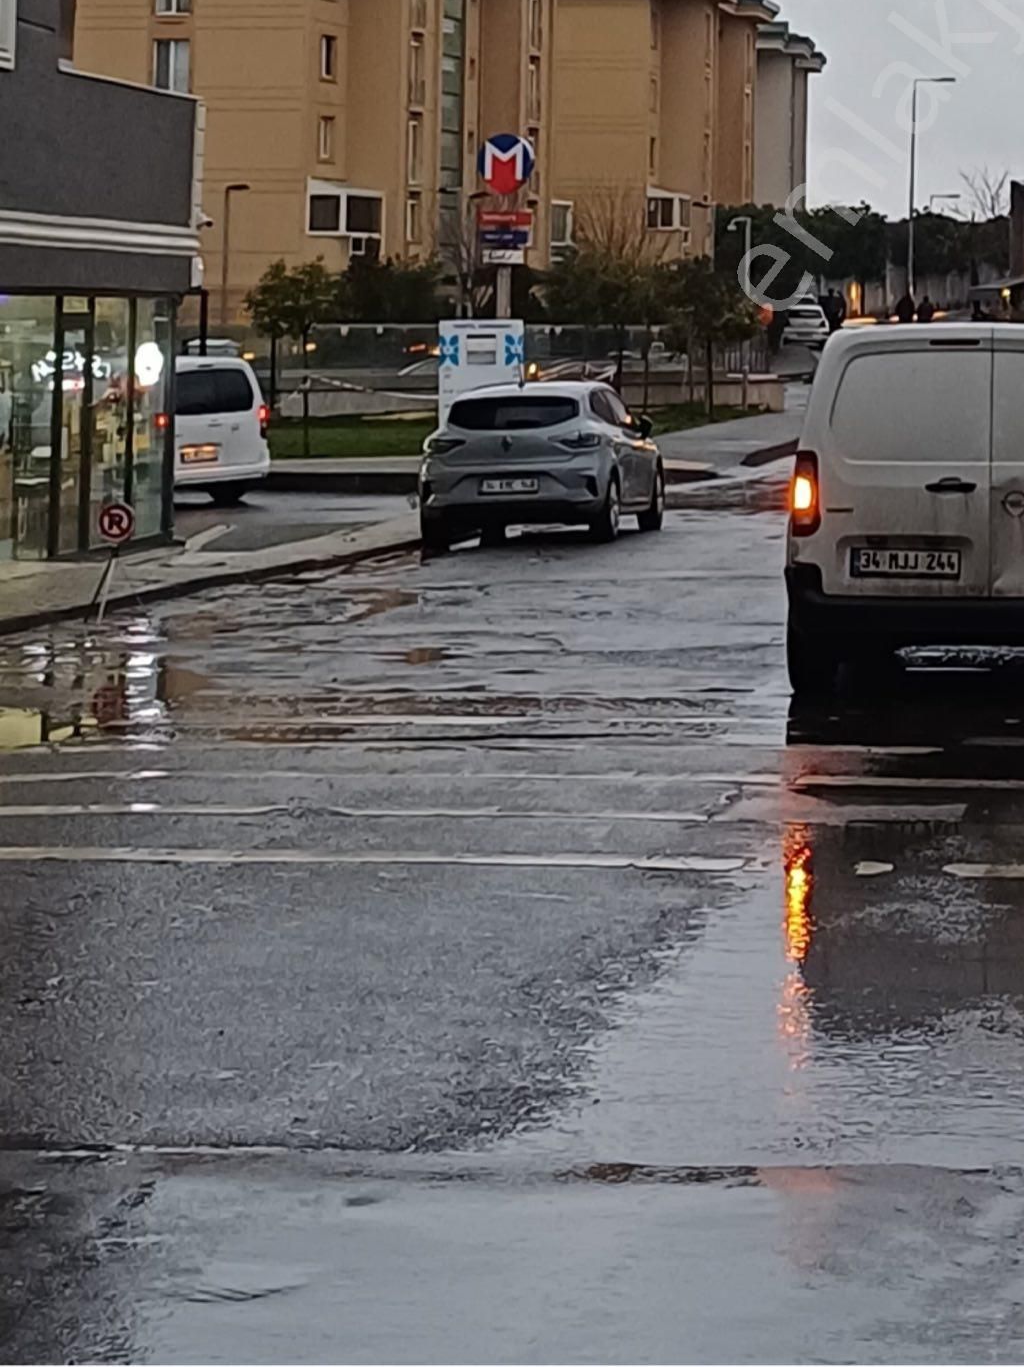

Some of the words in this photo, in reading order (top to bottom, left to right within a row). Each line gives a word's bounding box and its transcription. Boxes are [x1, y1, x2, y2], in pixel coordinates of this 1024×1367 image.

[861, 552, 880, 569] 34
[888, 552, 919, 570] MJJ
[926, 553, 956, 571] 244
